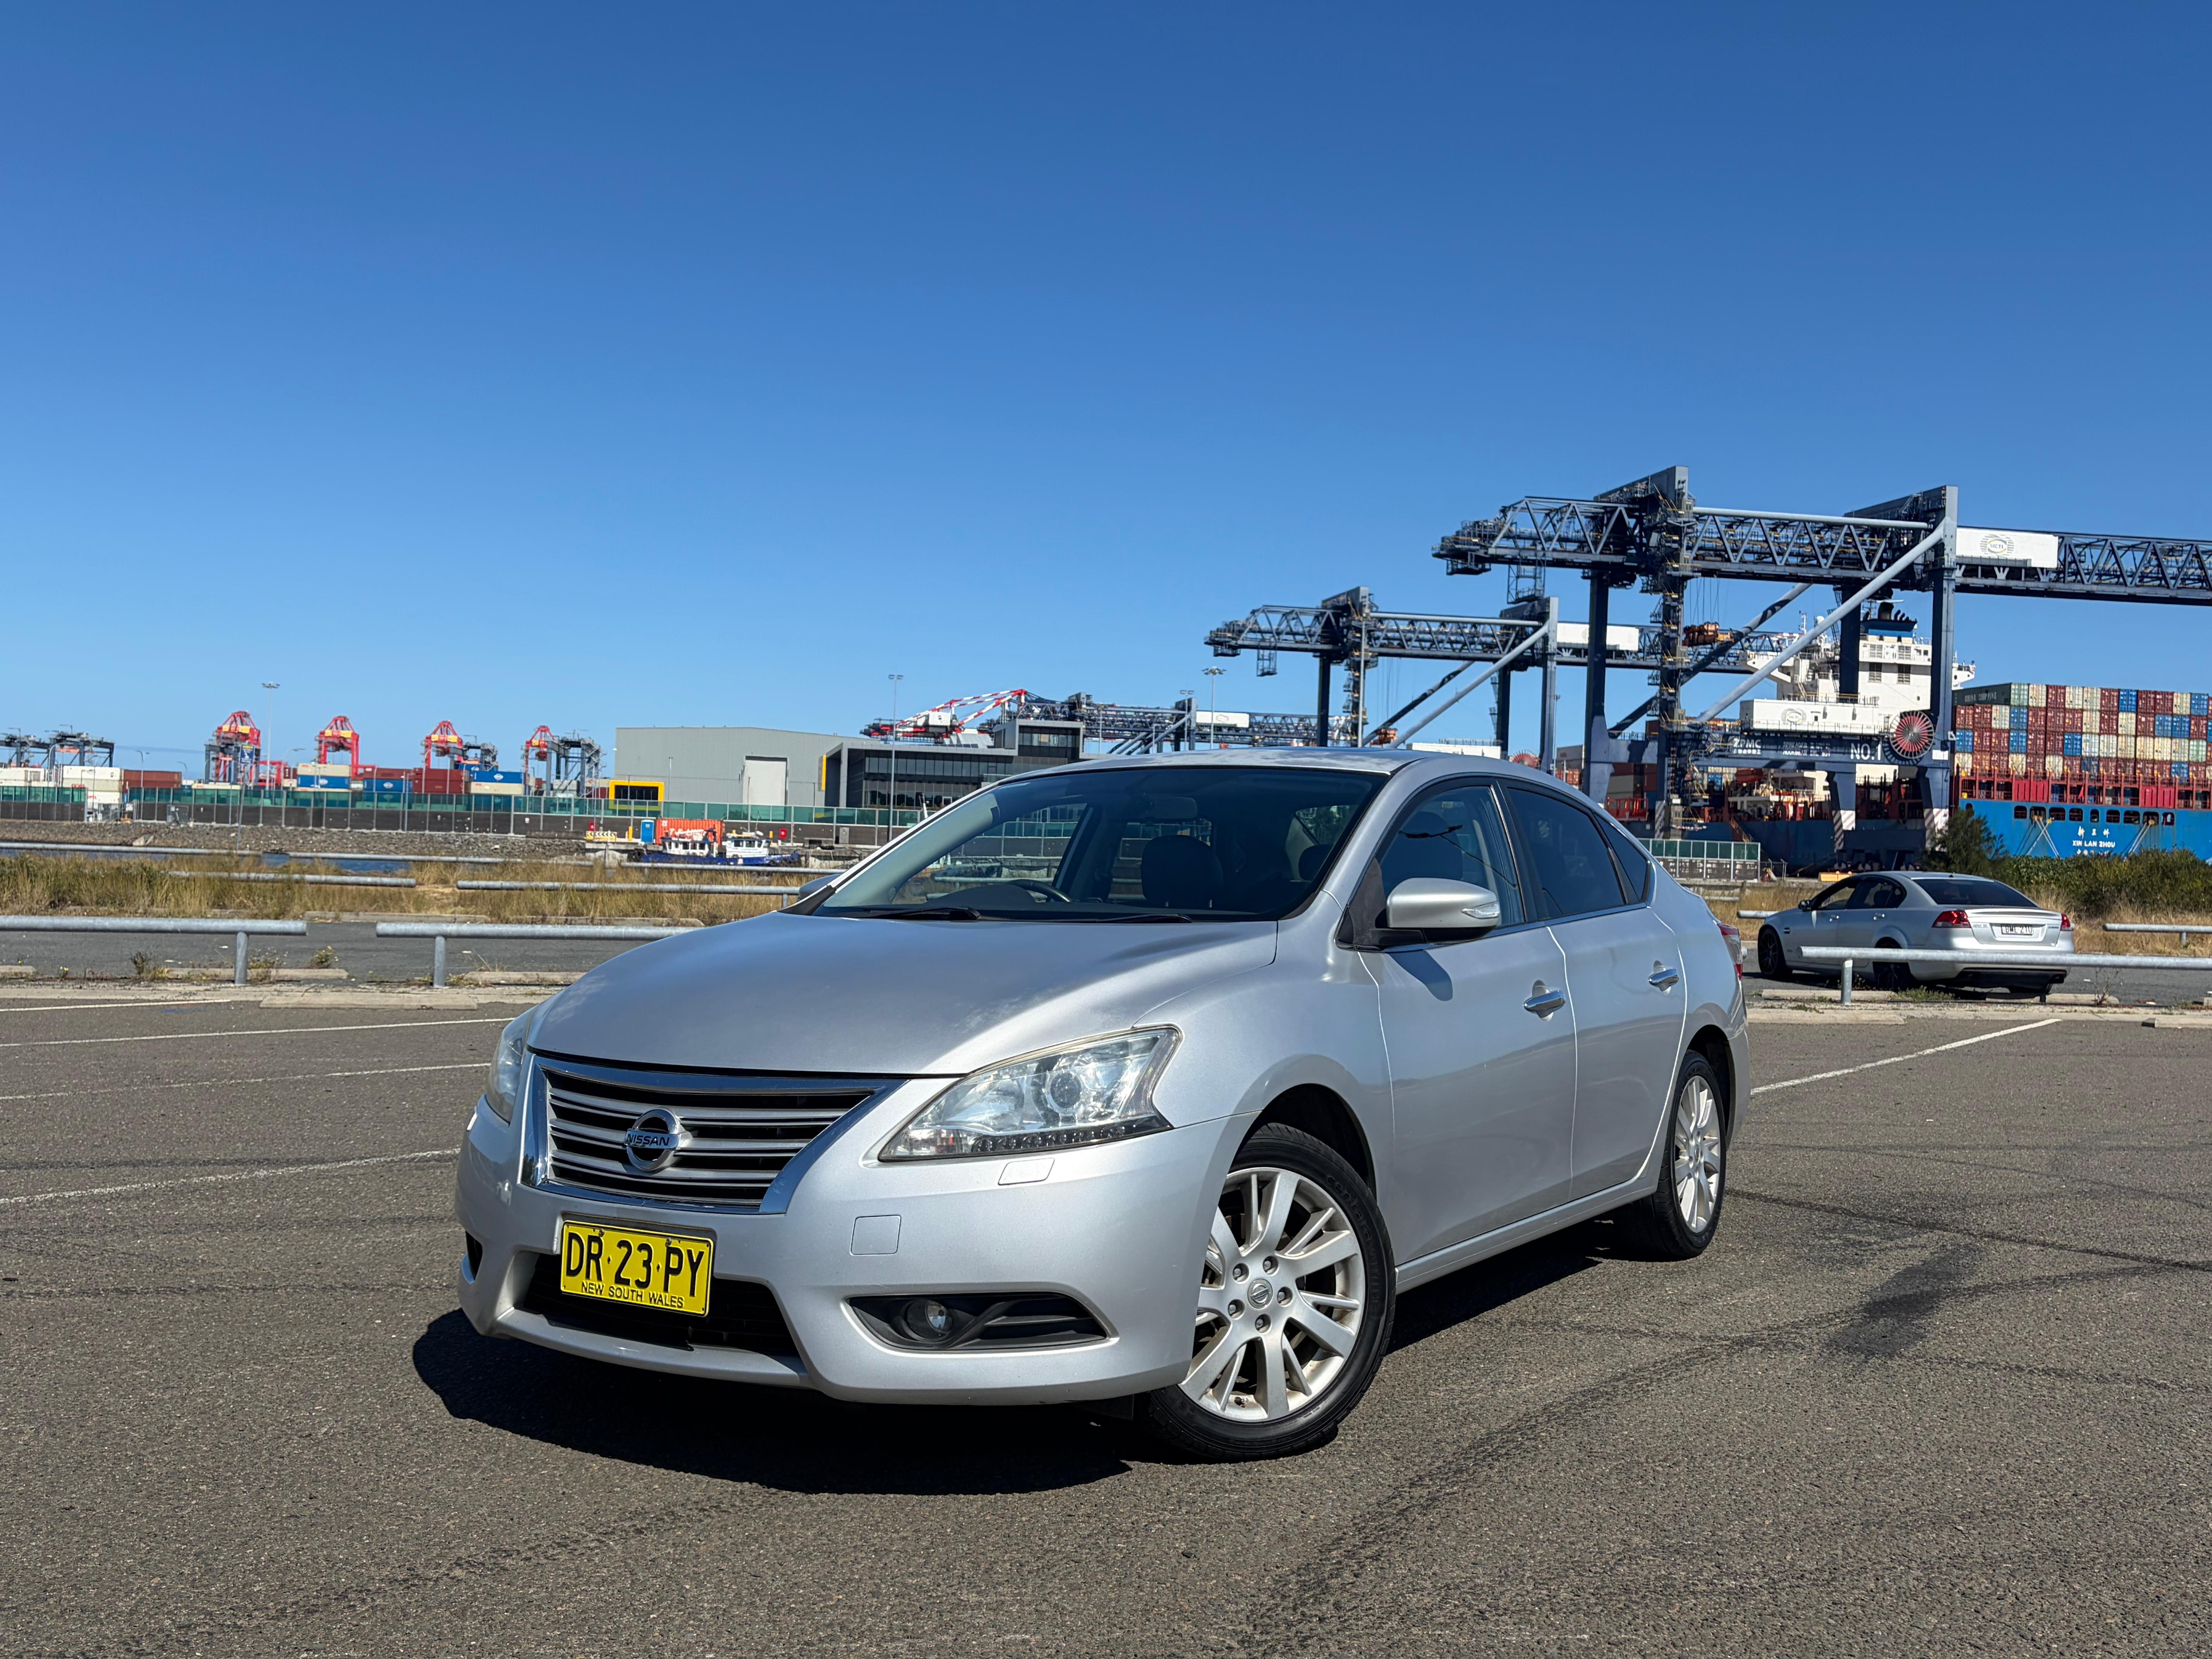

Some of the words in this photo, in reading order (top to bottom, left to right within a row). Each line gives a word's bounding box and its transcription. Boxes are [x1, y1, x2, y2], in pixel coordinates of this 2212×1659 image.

[1733, 738, 1761, 748] ZPMC
[1851, 742, 1881, 761] NO.1
[627, 1133, 670, 1146] NISSAN
[1326, 1174, 1372, 1242] centara
[581, 1281, 604, 1296] NEW
[608, 1286, 644, 1302] SOUTH
[649, 1291, 685, 1309] WALES
